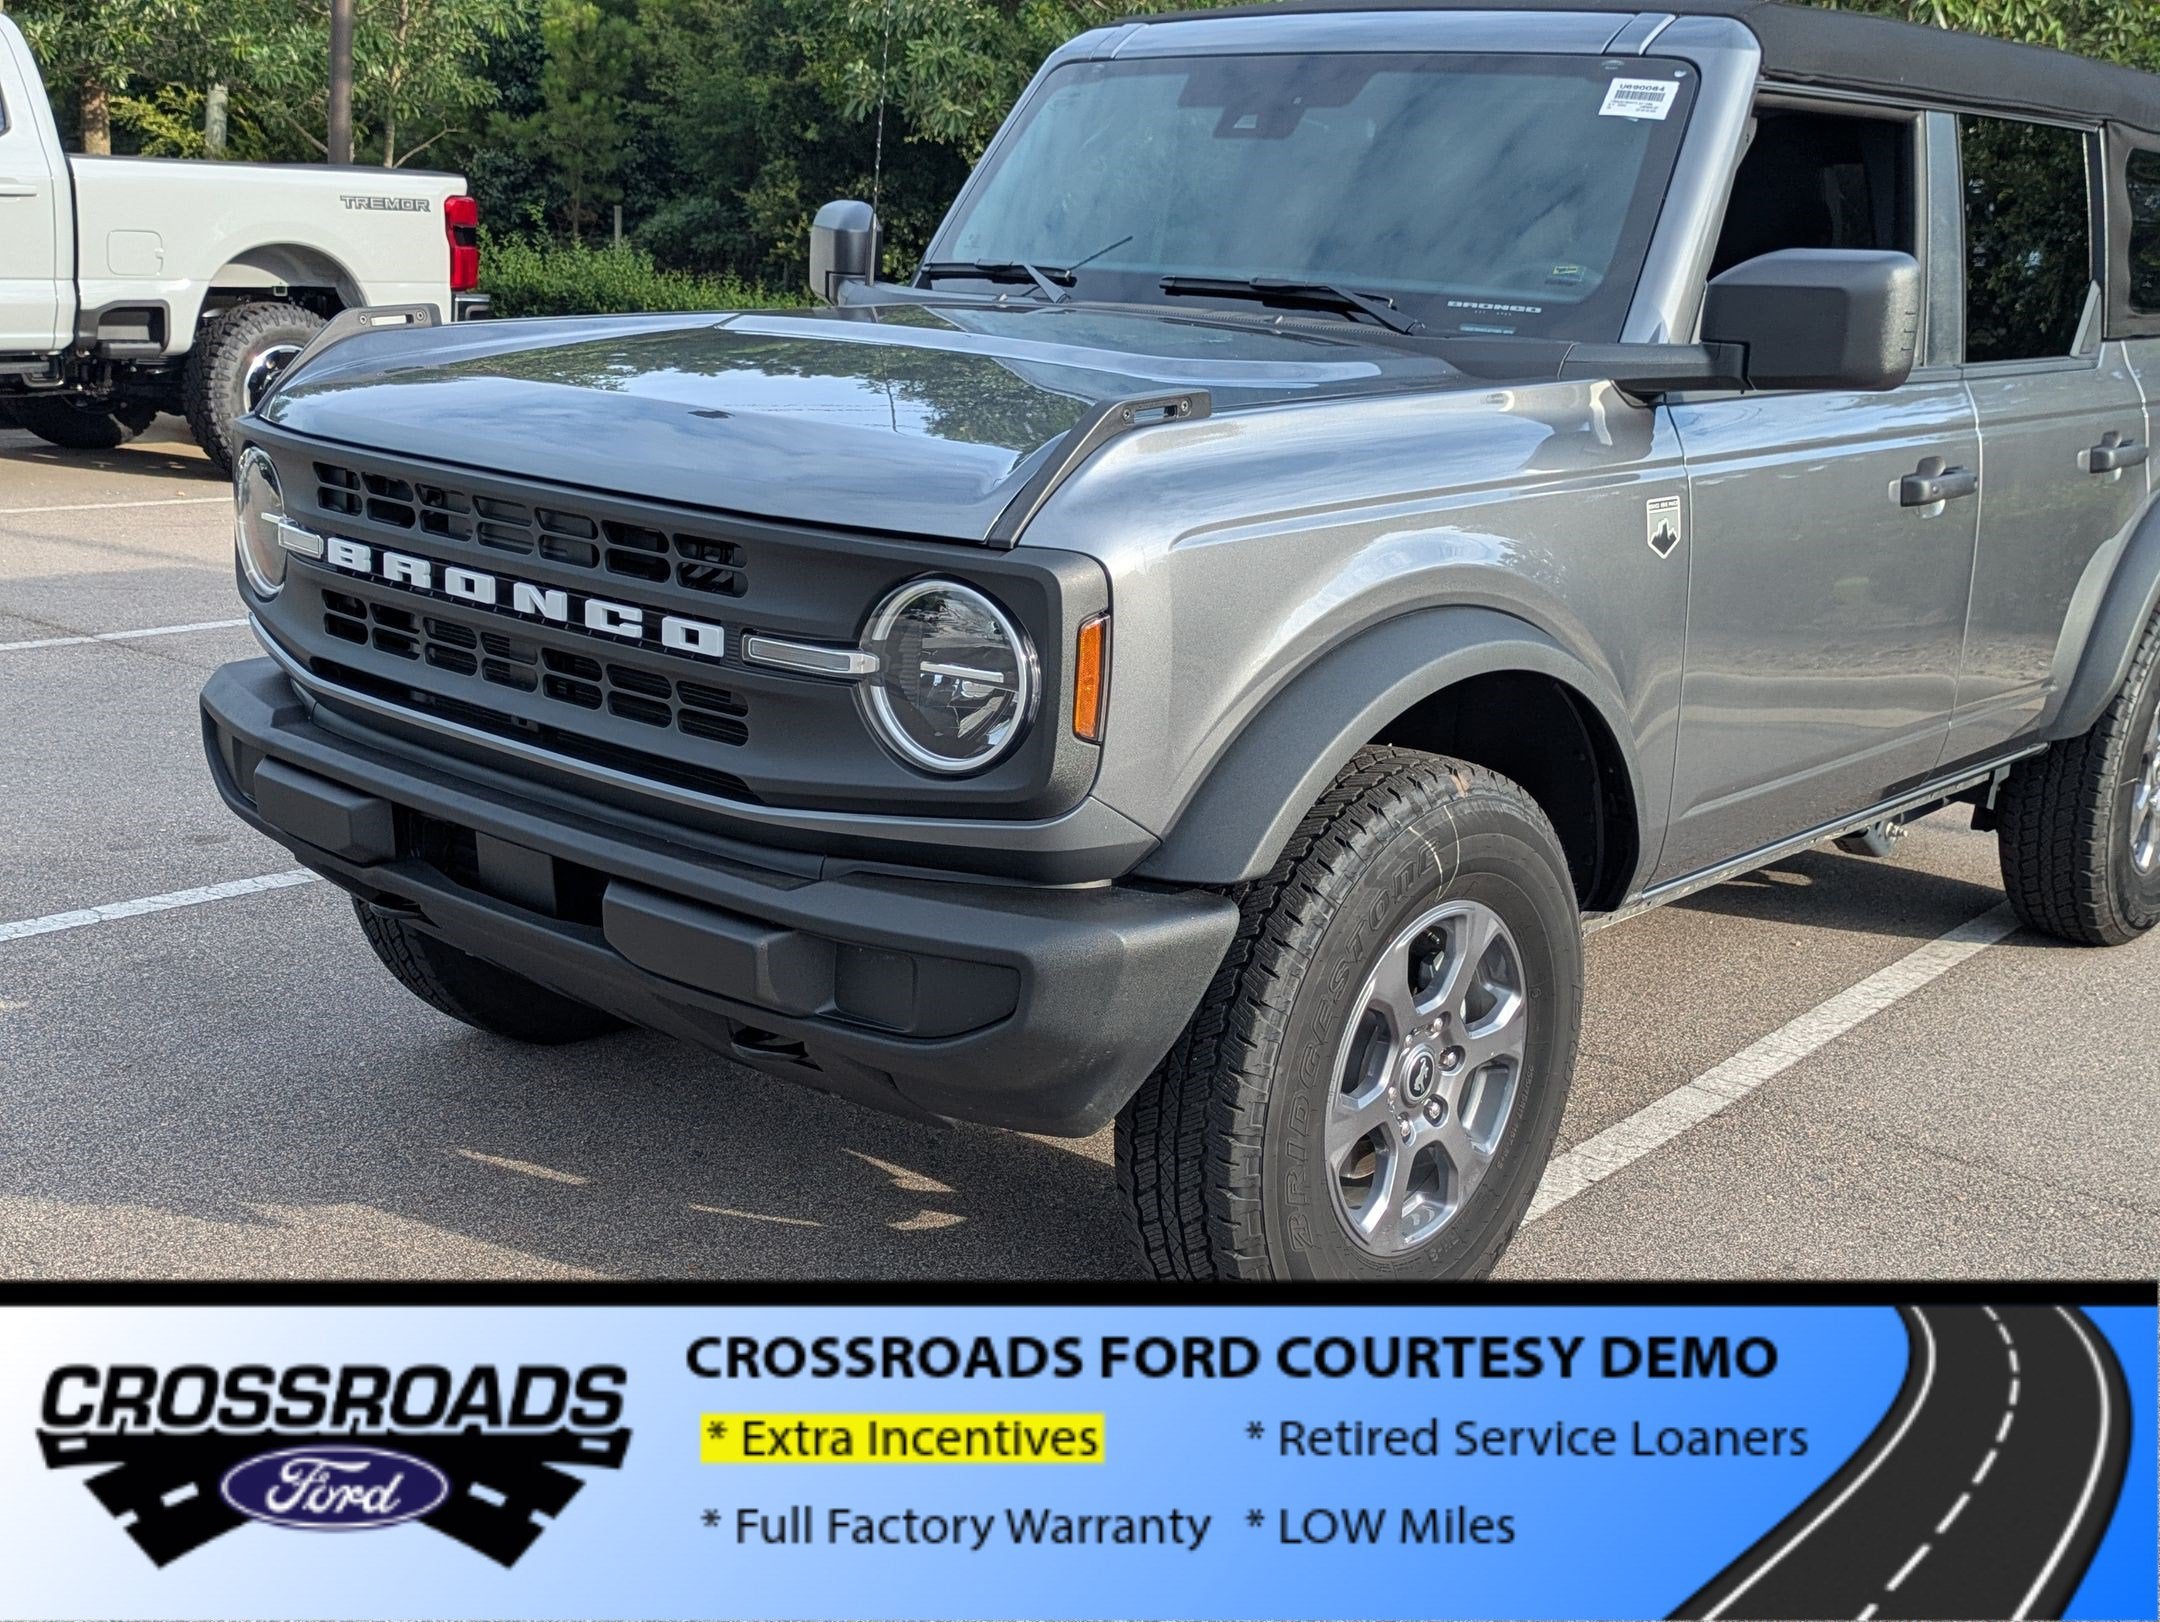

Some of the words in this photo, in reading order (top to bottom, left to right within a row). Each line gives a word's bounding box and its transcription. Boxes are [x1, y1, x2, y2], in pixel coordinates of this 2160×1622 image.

[340, 194, 431, 212] TREMOR
[1447, 300, 1542, 313] BRONCO
[327, 536, 725, 658] BRONCO
[1288, 836, 1444, 1252] BRIDGESTONE
